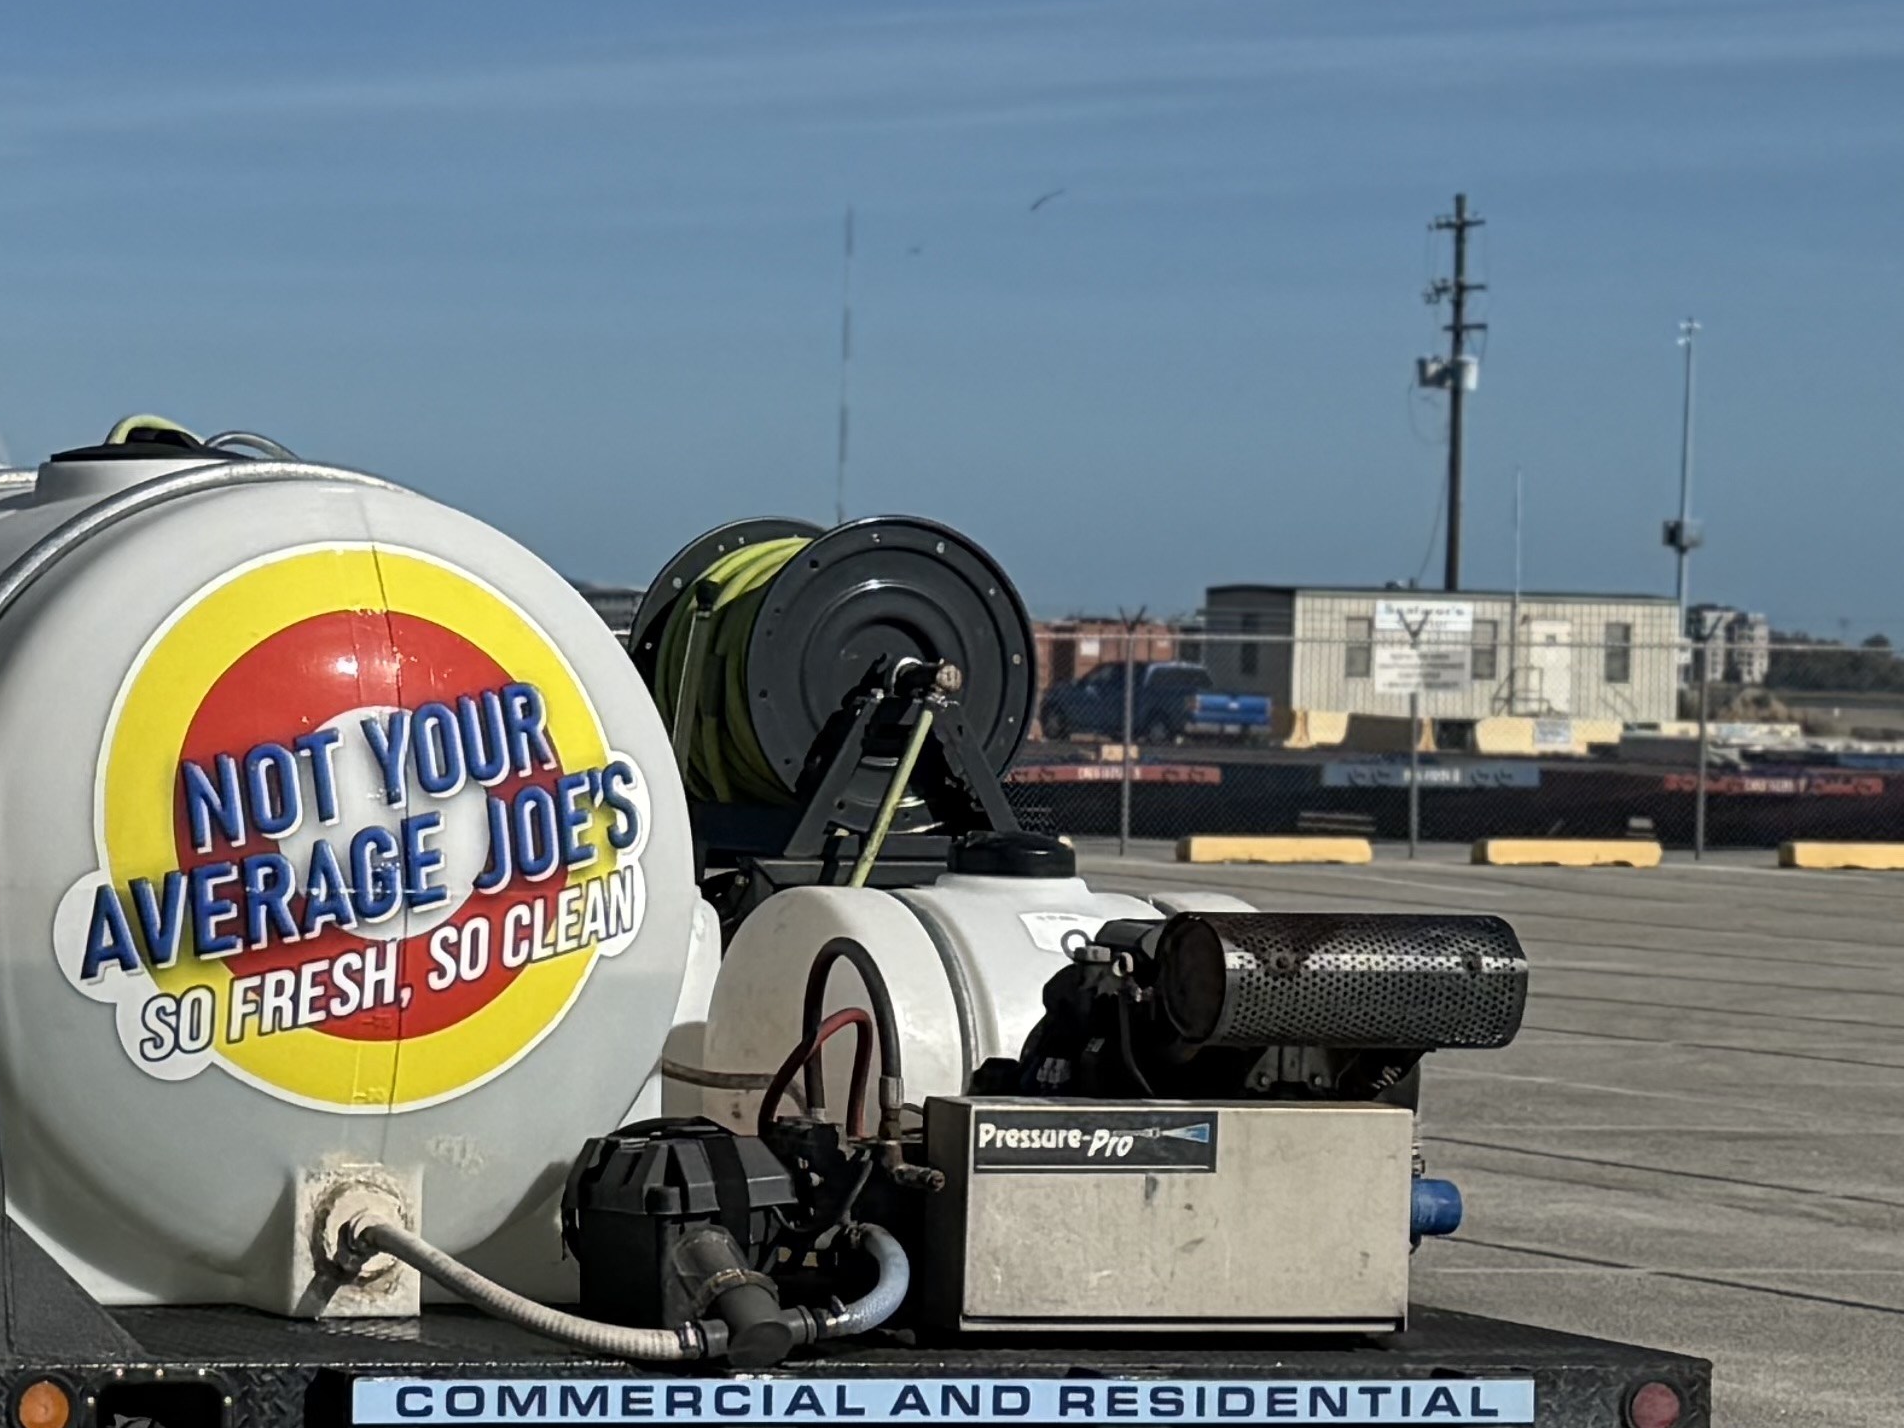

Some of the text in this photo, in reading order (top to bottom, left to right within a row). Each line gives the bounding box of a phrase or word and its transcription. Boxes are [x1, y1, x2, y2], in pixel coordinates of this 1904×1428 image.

[182, 682, 554, 852] NOT YOUR
[79, 760, 644, 982] AVERAGE JOE'S
[139, 865, 636, 1062] SO FRESH, SO CLEAN
[978, 1123, 1135, 1158] Pressure-Pro
[395, 1383, 1501, 1419] COMMERCIAL AND RESIDENTIAL
